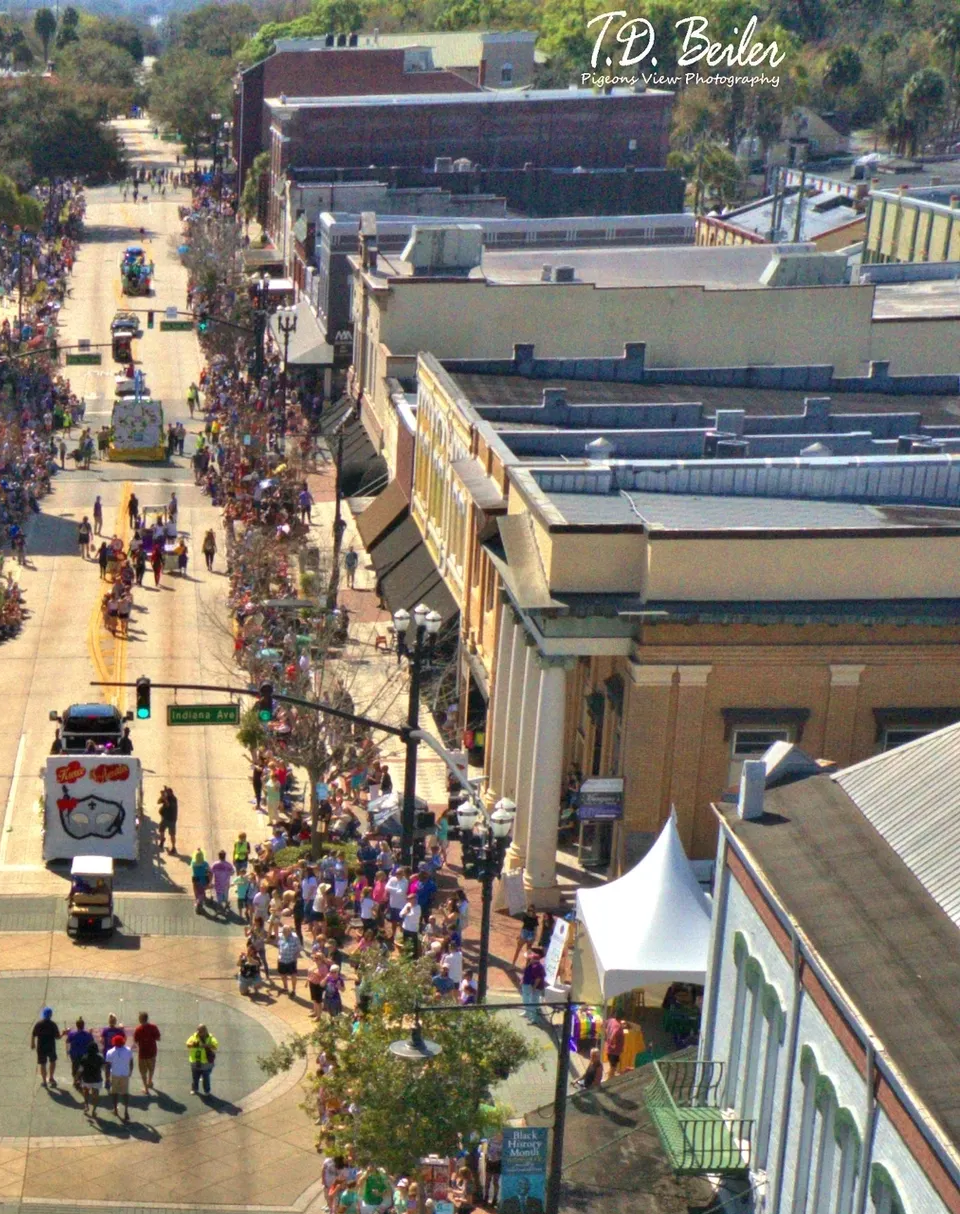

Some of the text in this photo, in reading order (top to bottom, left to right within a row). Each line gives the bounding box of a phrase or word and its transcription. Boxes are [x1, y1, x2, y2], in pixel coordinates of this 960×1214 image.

[172, 710, 236, 720] Indiana Ave
[513, 1129, 538, 1140] Black
[508, 1140, 543, 1149] History
[510, 1148, 540, 1157] Month
